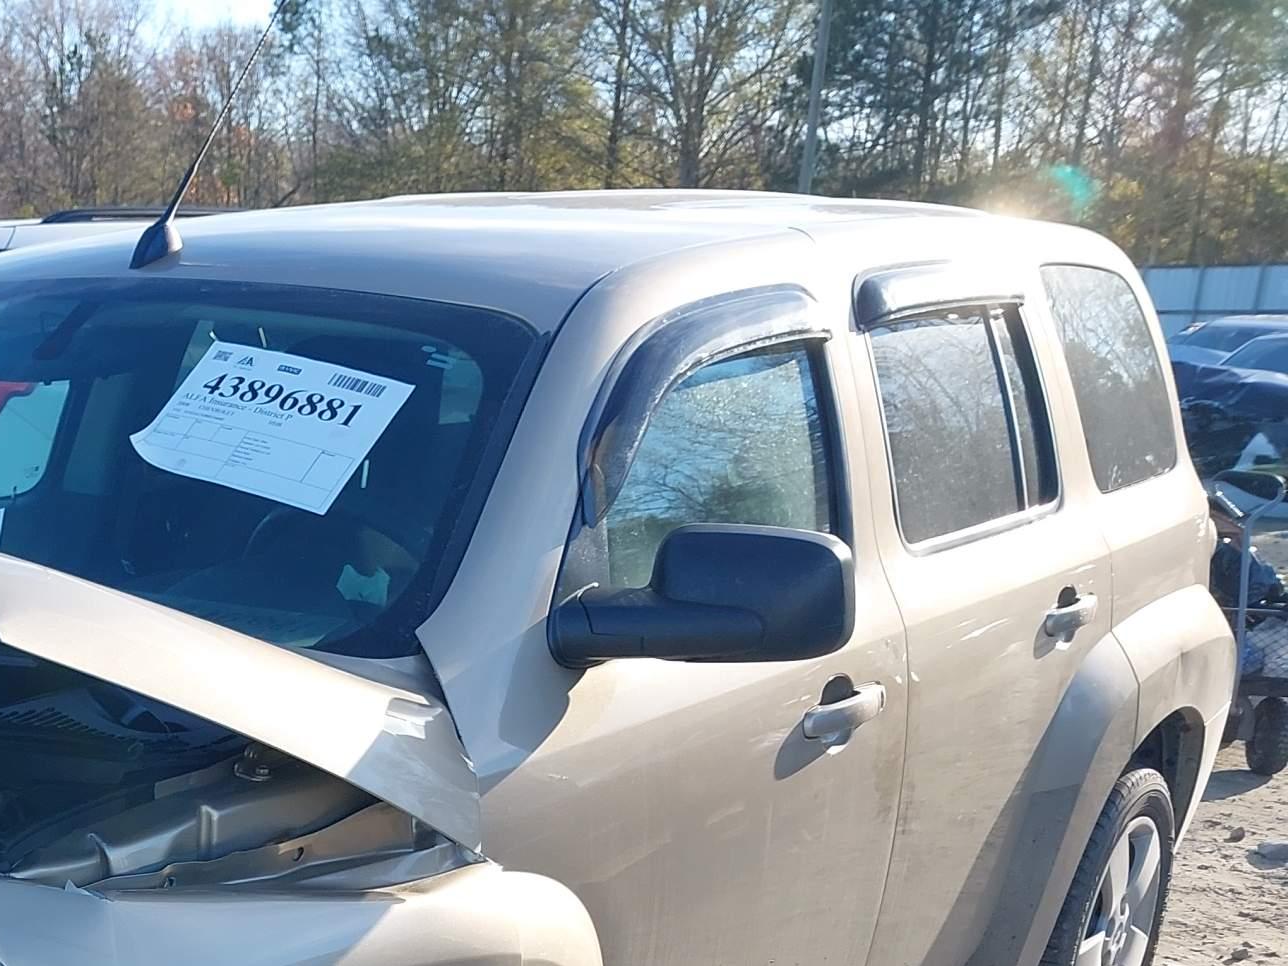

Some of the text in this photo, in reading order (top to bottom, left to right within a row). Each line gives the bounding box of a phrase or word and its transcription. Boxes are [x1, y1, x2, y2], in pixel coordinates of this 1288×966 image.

[202, 373, 363, 428] 43896881
[209, 397, 247, 412] Insurance
[253, 406, 284, 420] District
